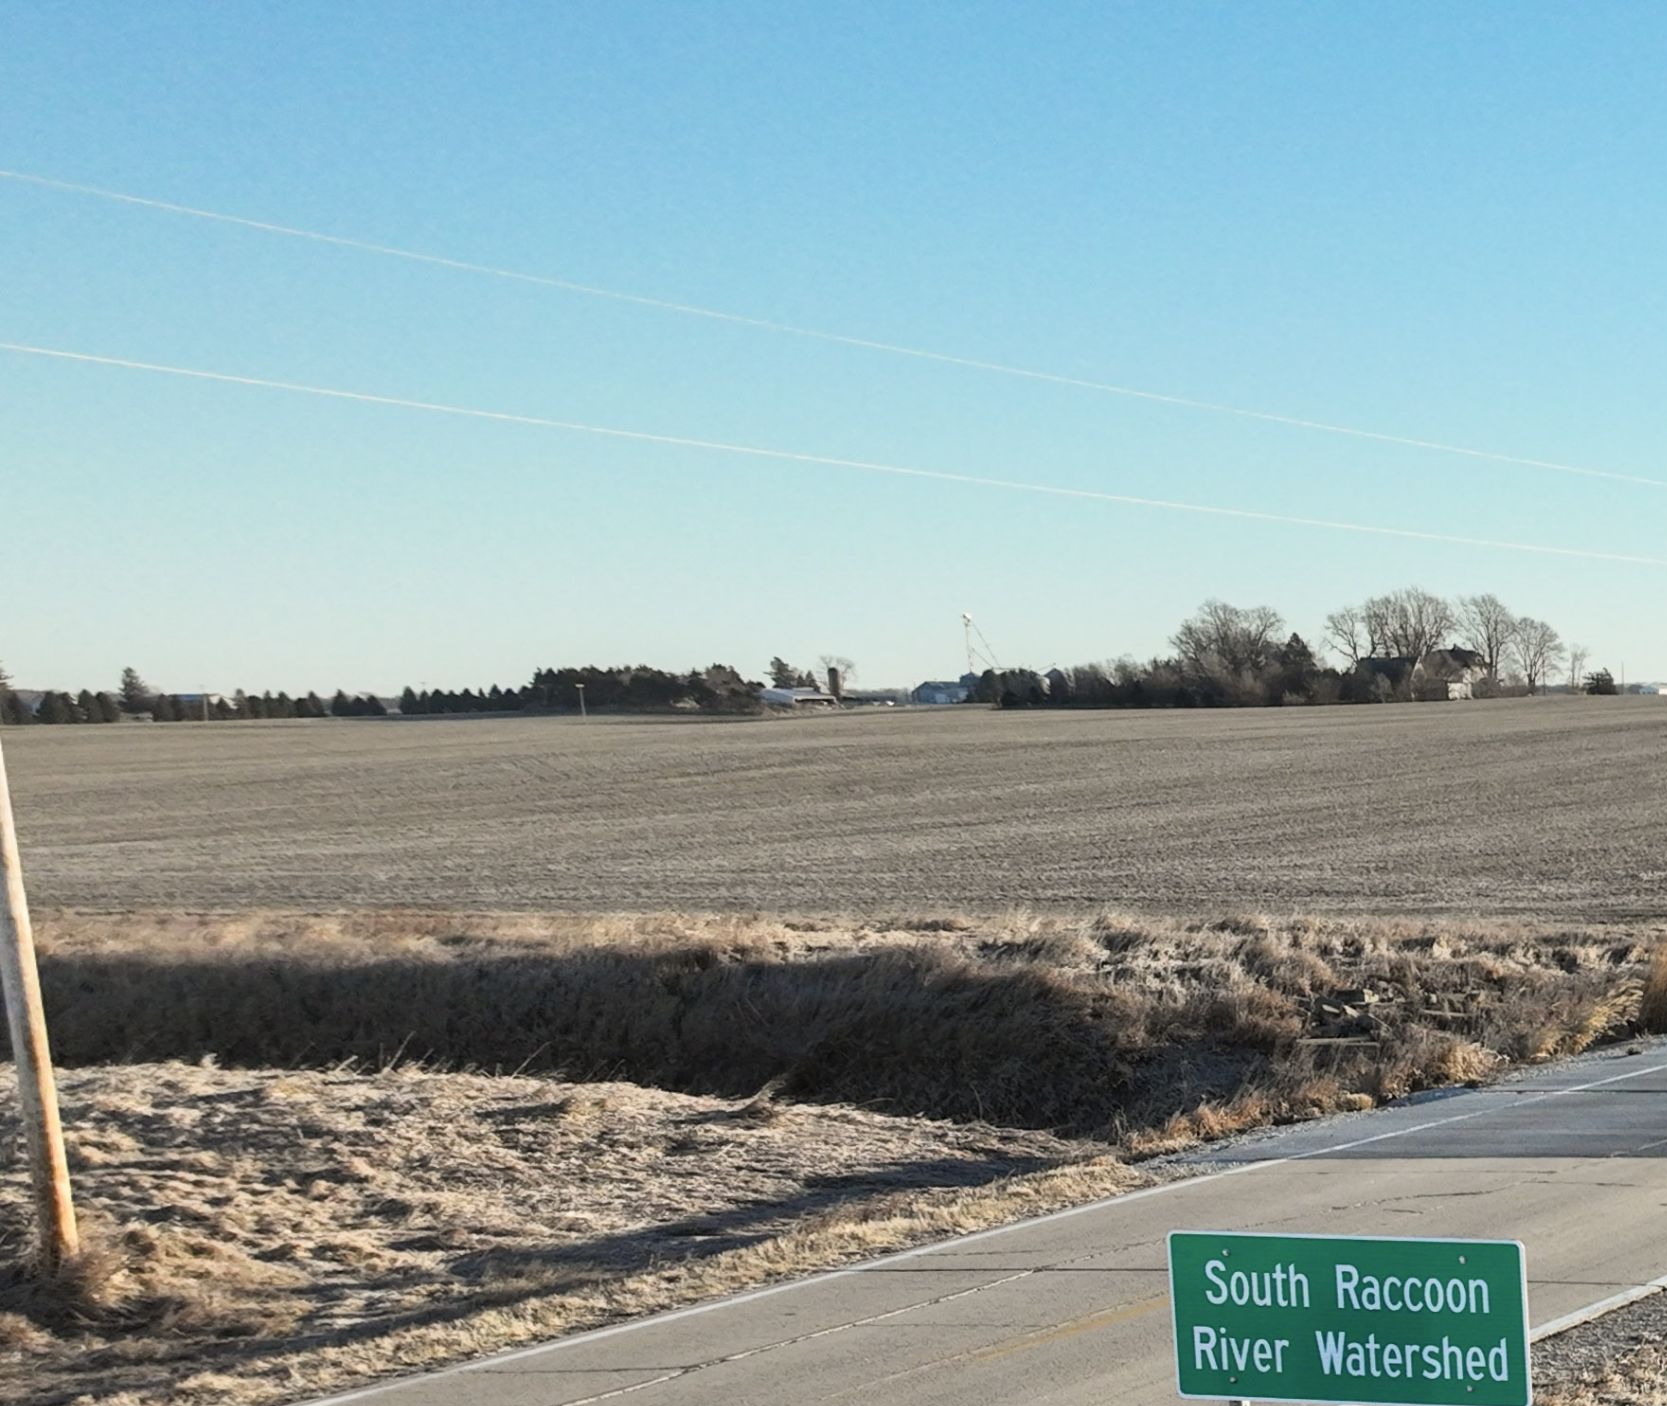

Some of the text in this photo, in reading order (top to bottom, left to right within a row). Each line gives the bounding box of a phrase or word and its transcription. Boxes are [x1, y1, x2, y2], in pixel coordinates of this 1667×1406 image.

[1205, 1259, 1490, 1314] South Raccoon
[1193, 1326, 1508, 1382] River Watershed
